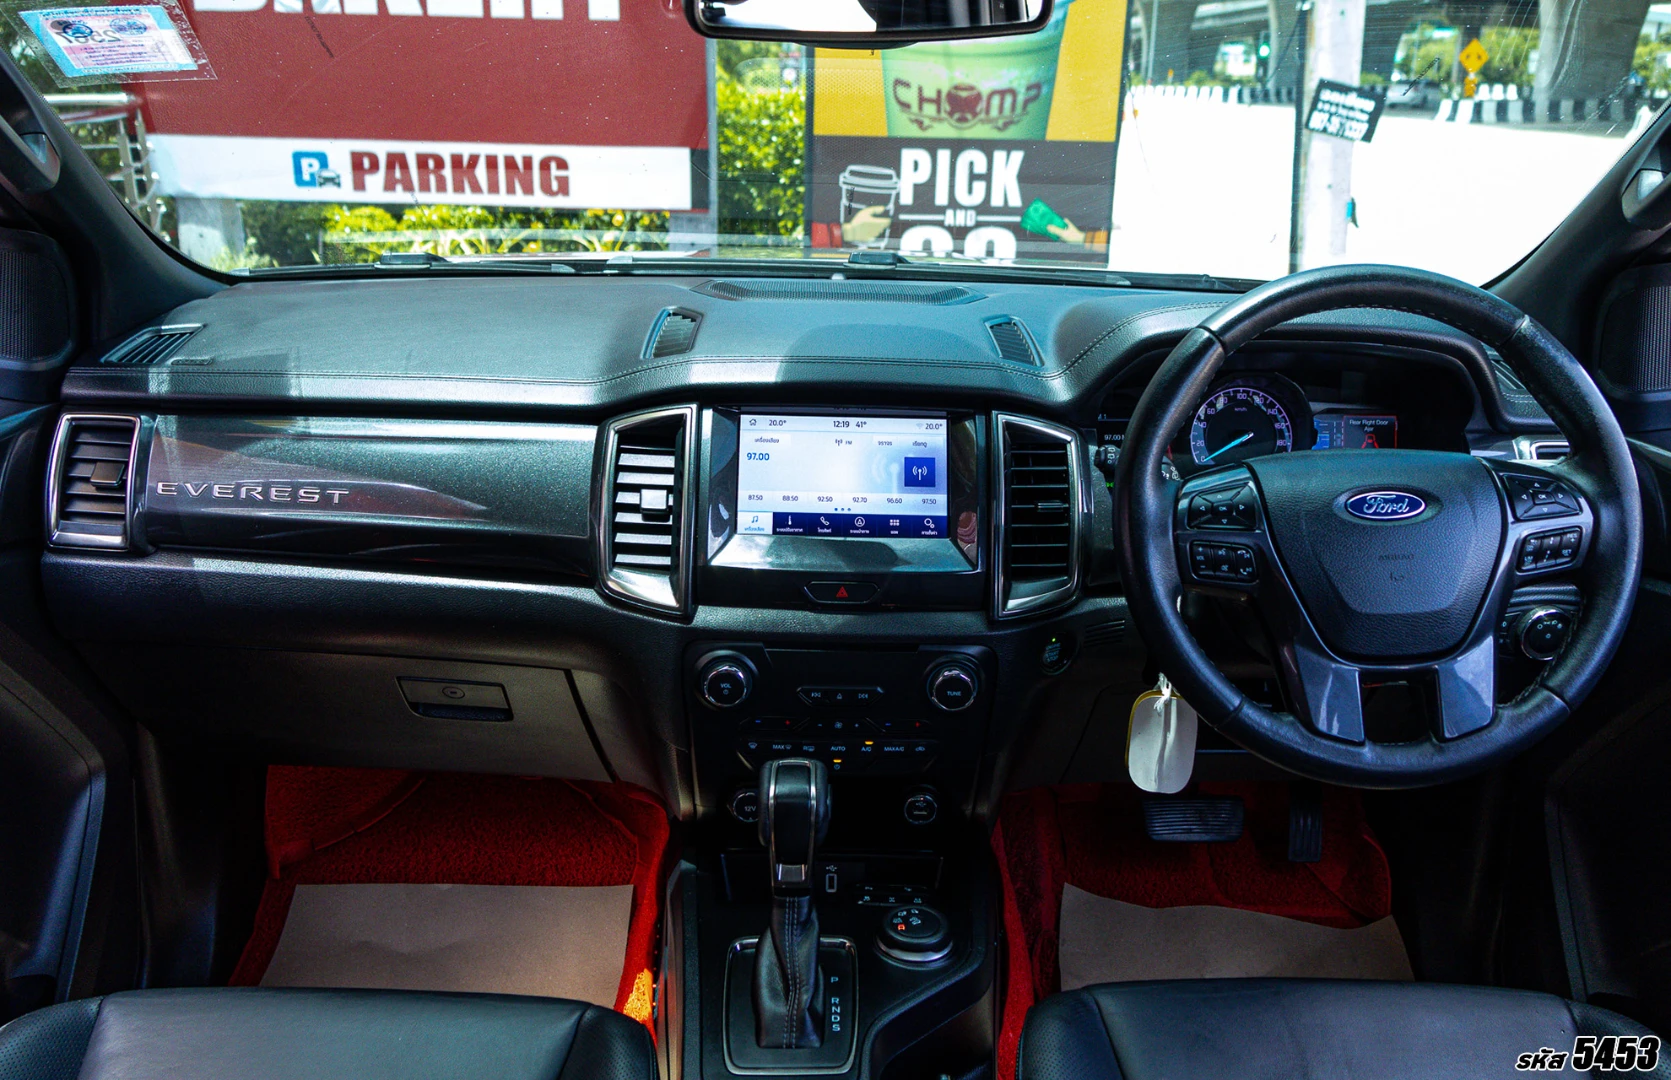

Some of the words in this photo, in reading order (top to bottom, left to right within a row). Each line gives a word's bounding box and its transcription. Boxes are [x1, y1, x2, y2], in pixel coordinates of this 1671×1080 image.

[350, 151, 570, 198] PARKING
[899, 148, 1025, 207] PICK
[944, 209, 976, 228] AND
[1236, 392, 1248, 400] 100
[833, 420, 850, 428] 12:19
[746, 452, 770, 461] 97.00
[156, 481, 349, 504] EVEREST
[1363, 494, 1410, 513] Ford
[719, 682, 732, 690] VOL
[831, 997, 840, 1005] R
[831, 1023, 841, 1032] S
